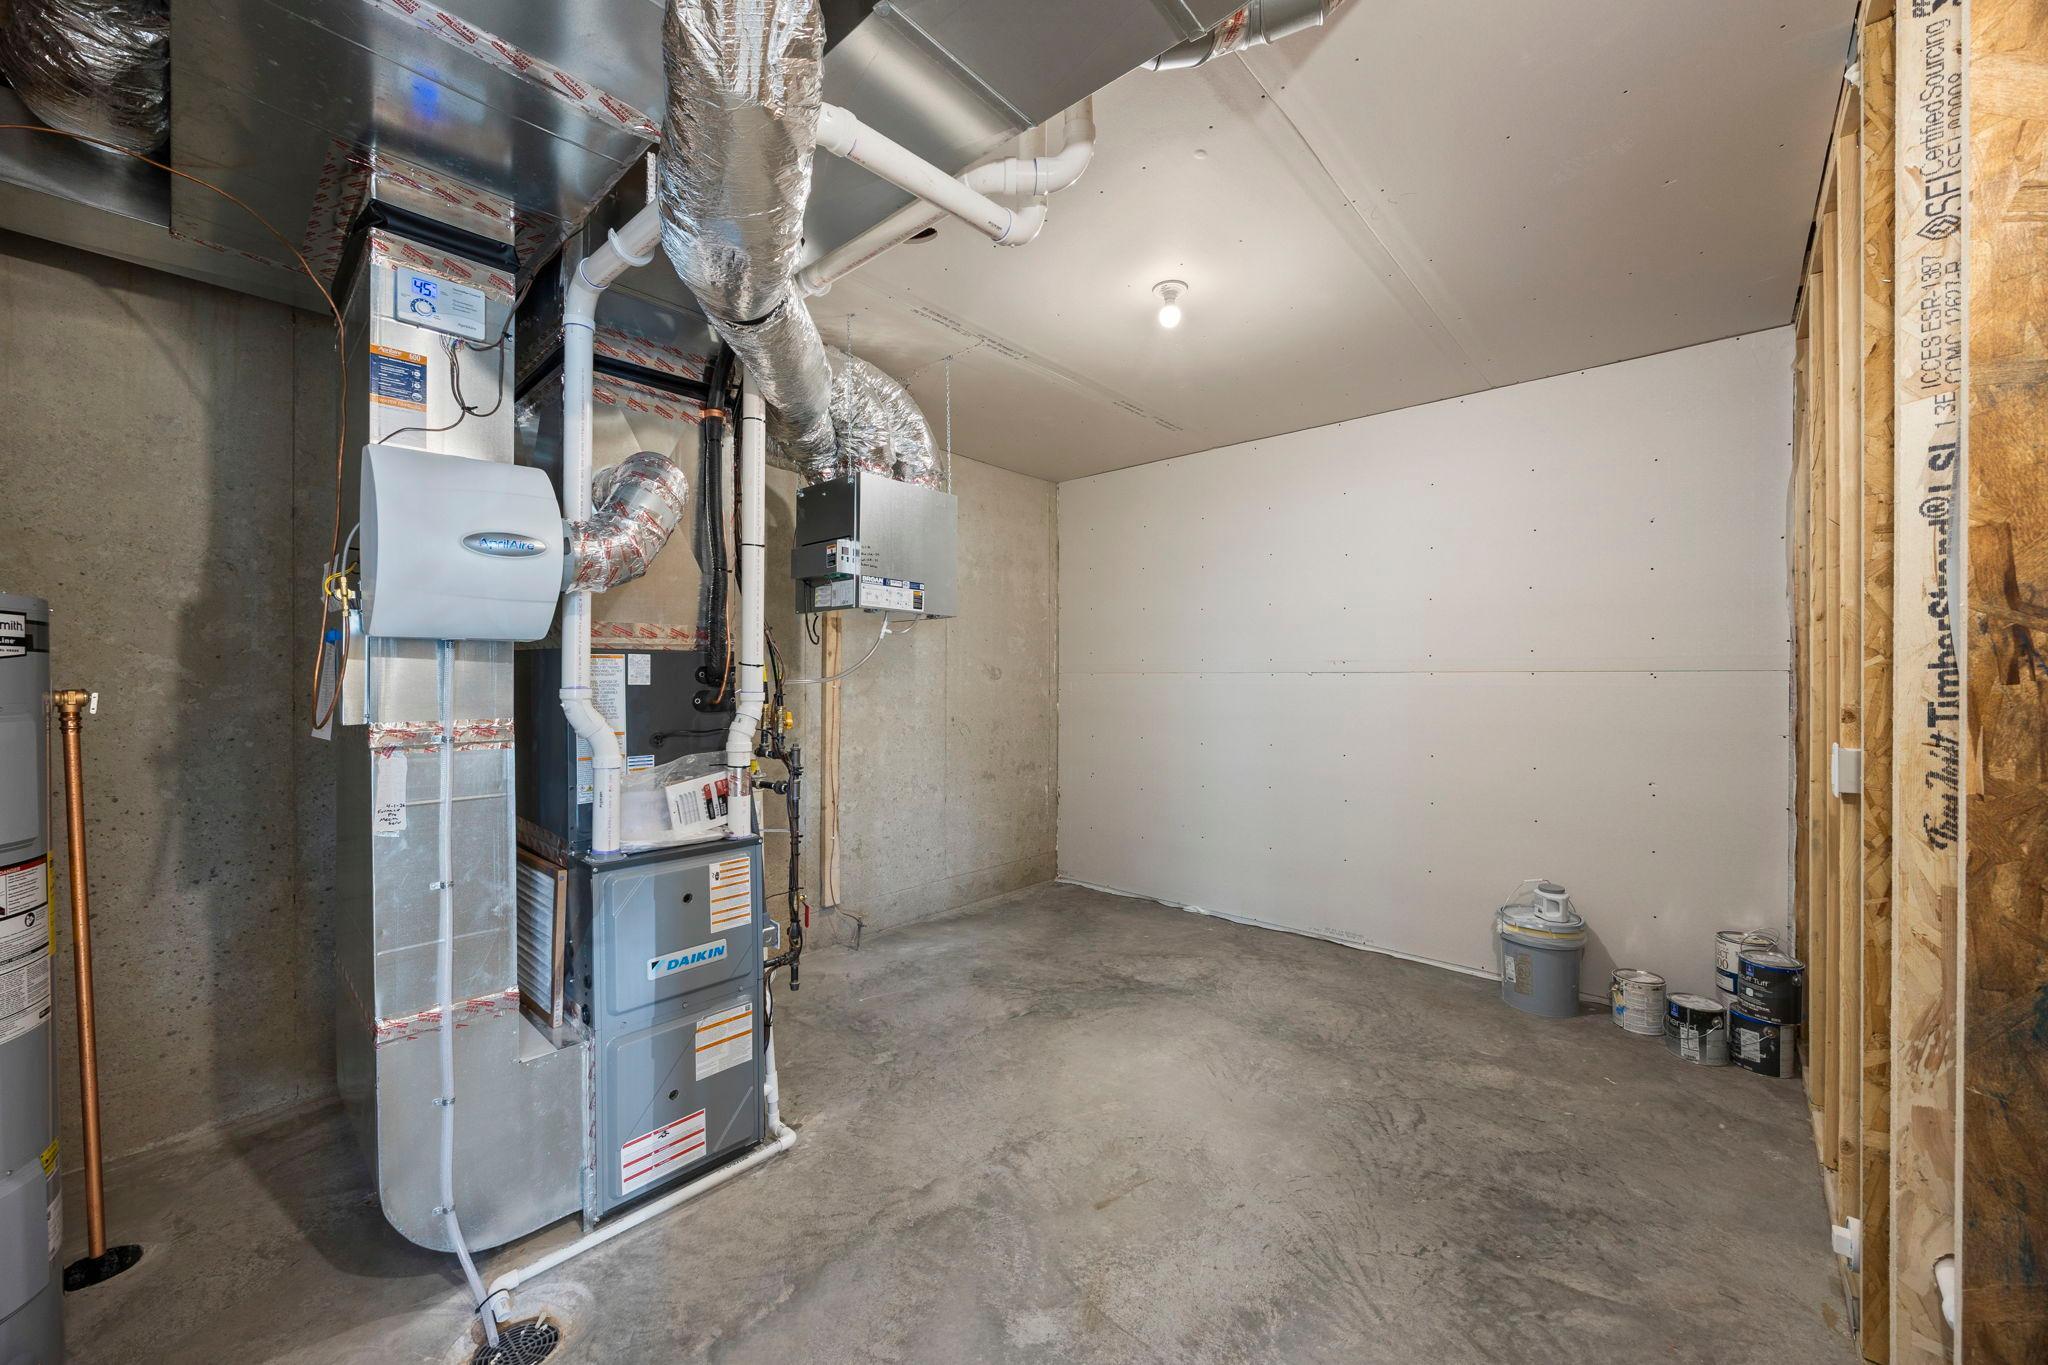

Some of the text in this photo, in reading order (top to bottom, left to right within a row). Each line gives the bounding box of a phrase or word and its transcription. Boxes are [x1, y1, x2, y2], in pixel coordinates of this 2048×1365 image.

[1919, 18, 1952, 100] Sourcing
[1919, 99, 1945, 176] Certified
[413, 280, 431, 297] 45
[1920, 255, 1941, 333] ESR-1387
[479, 537, 535, 550] AprilAire
[0, 620, 23, 631] mith
[666, 945, 726, 971] DAIKIN
